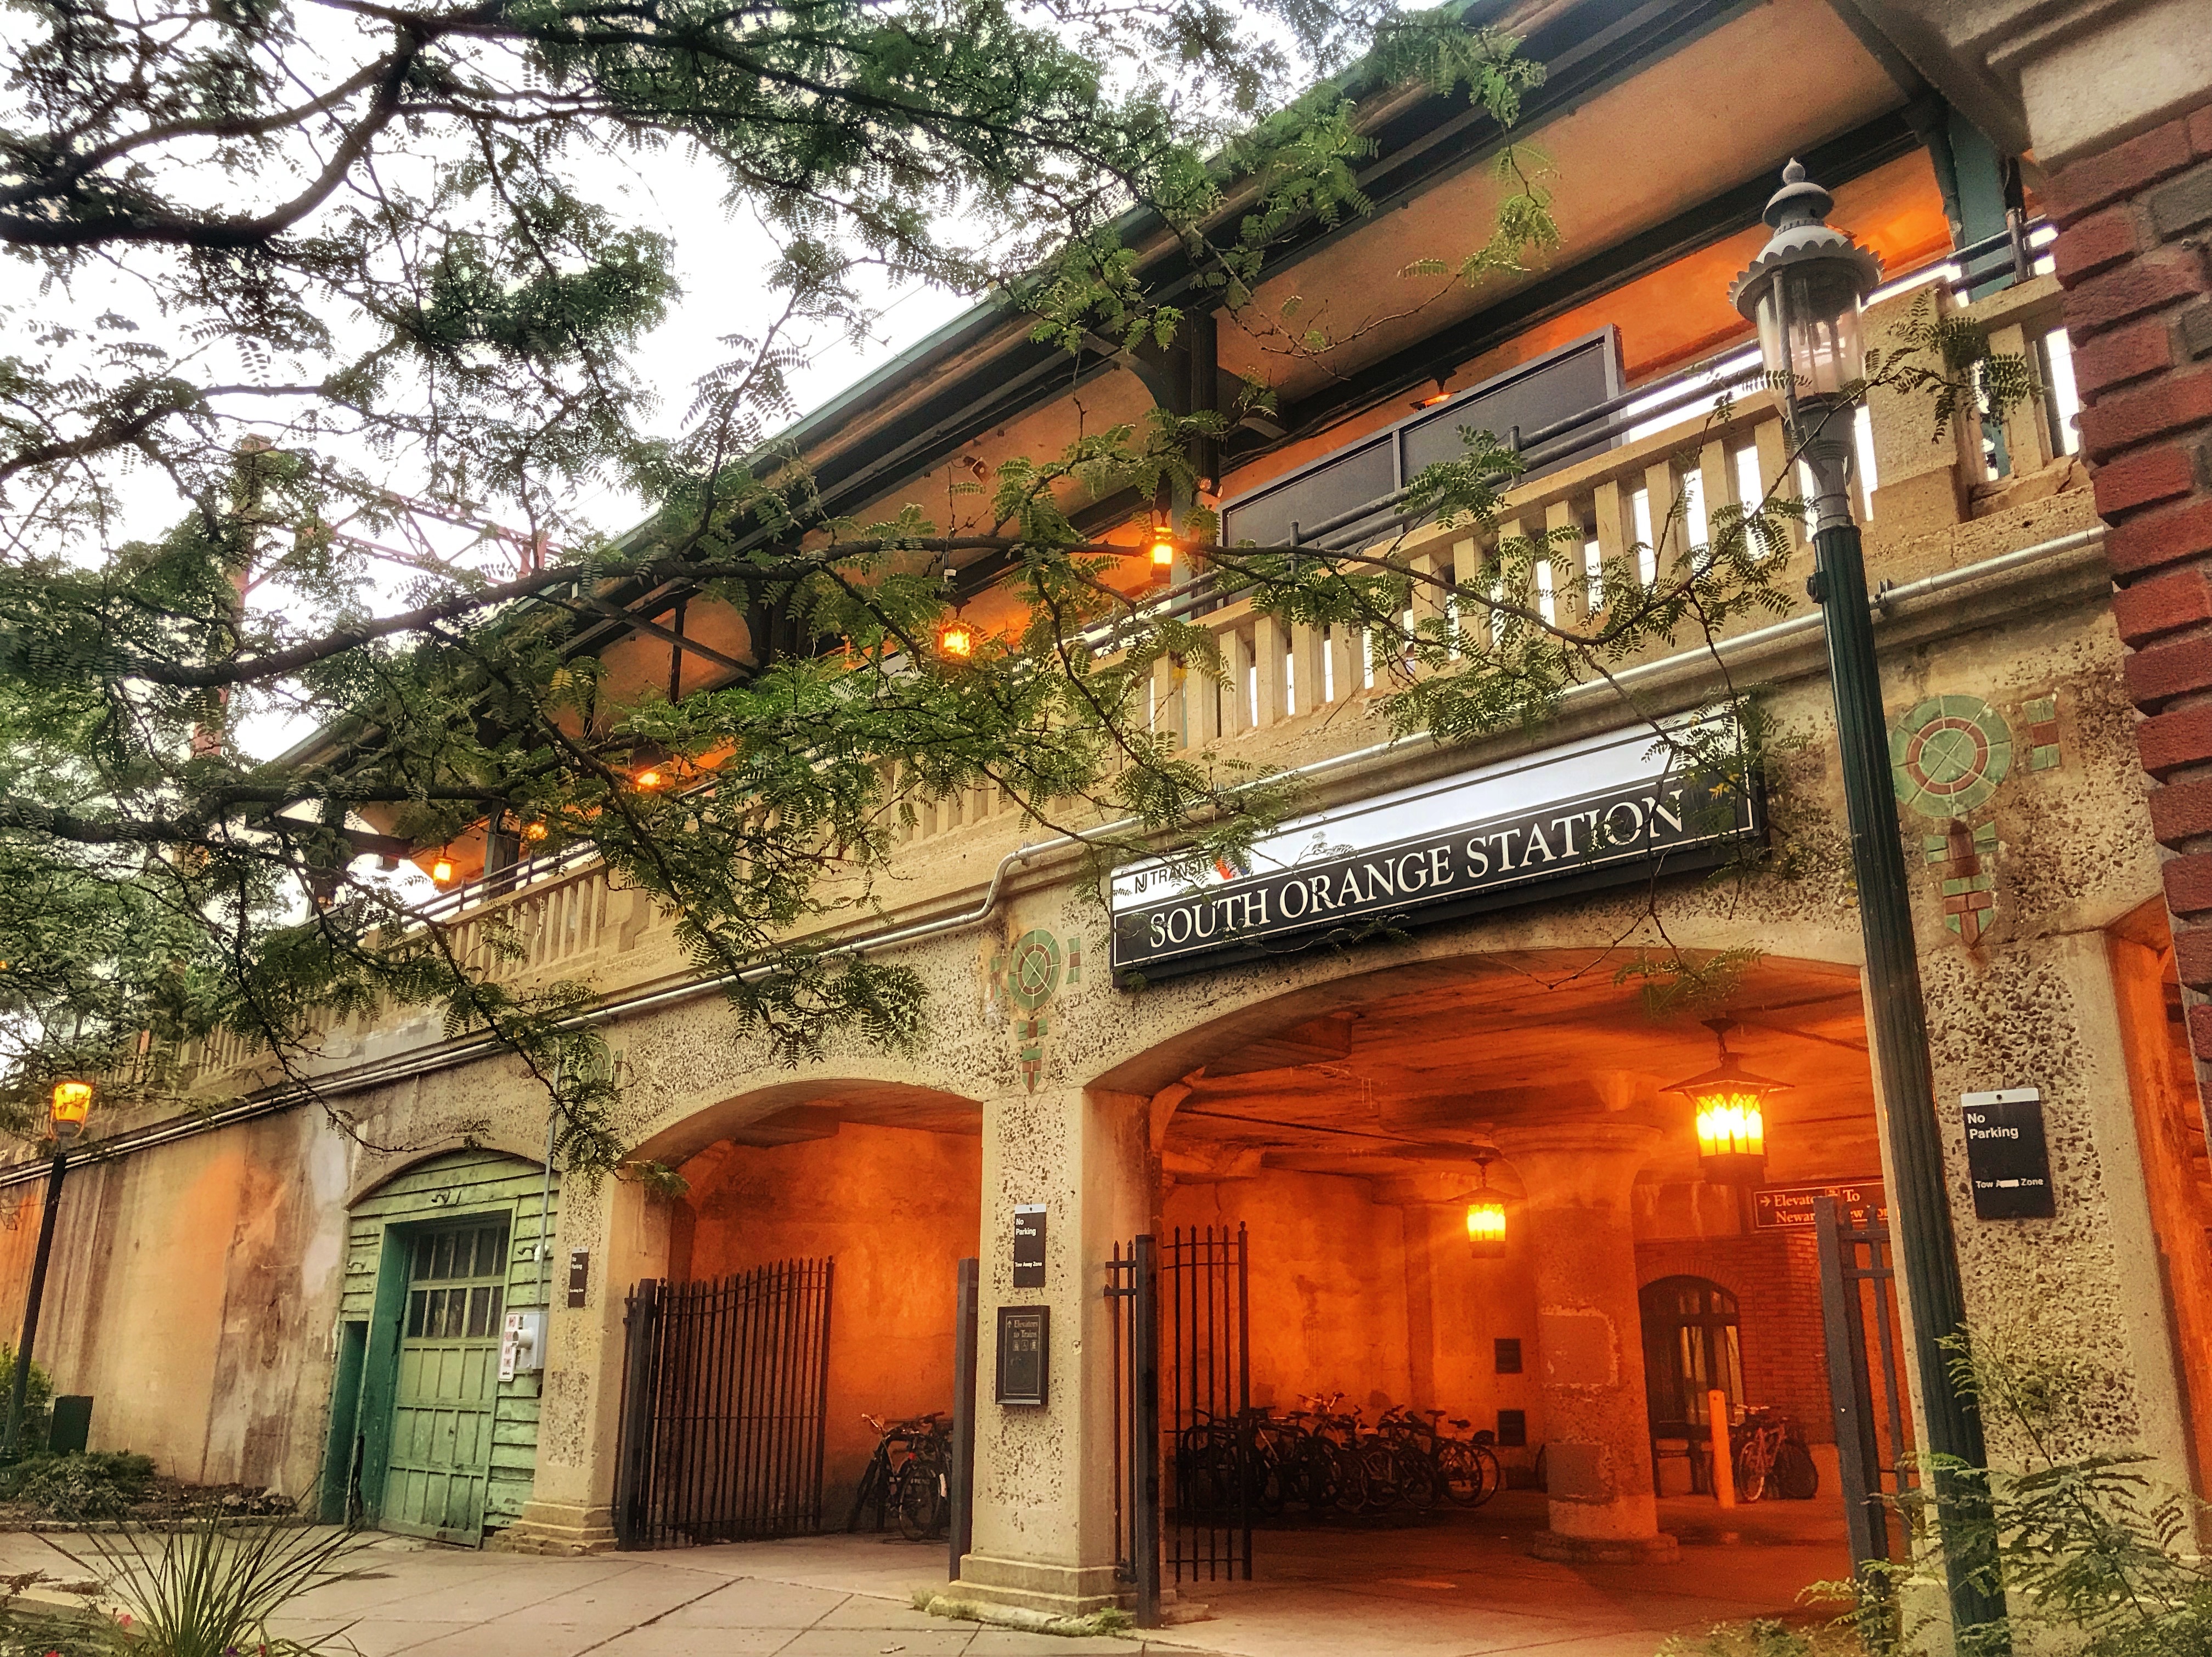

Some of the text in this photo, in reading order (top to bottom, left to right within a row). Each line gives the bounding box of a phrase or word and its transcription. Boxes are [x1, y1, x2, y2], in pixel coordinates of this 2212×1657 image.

[1150, 789, 1683, 948] SOUTH ORANGE STATION
[1967, 1113, 1985, 1124] No
[1969, 1127, 2019, 1139] Parking
[1976, 1180, 1993, 1189] Tow
[2021, 1178, 2044, 1186] Zone
[1773, 1189, 1860, 1207] Elevat To
[1775, 1211, 1815, 1223] Newar
[1015, 1227, 1036, 1236] Parking
